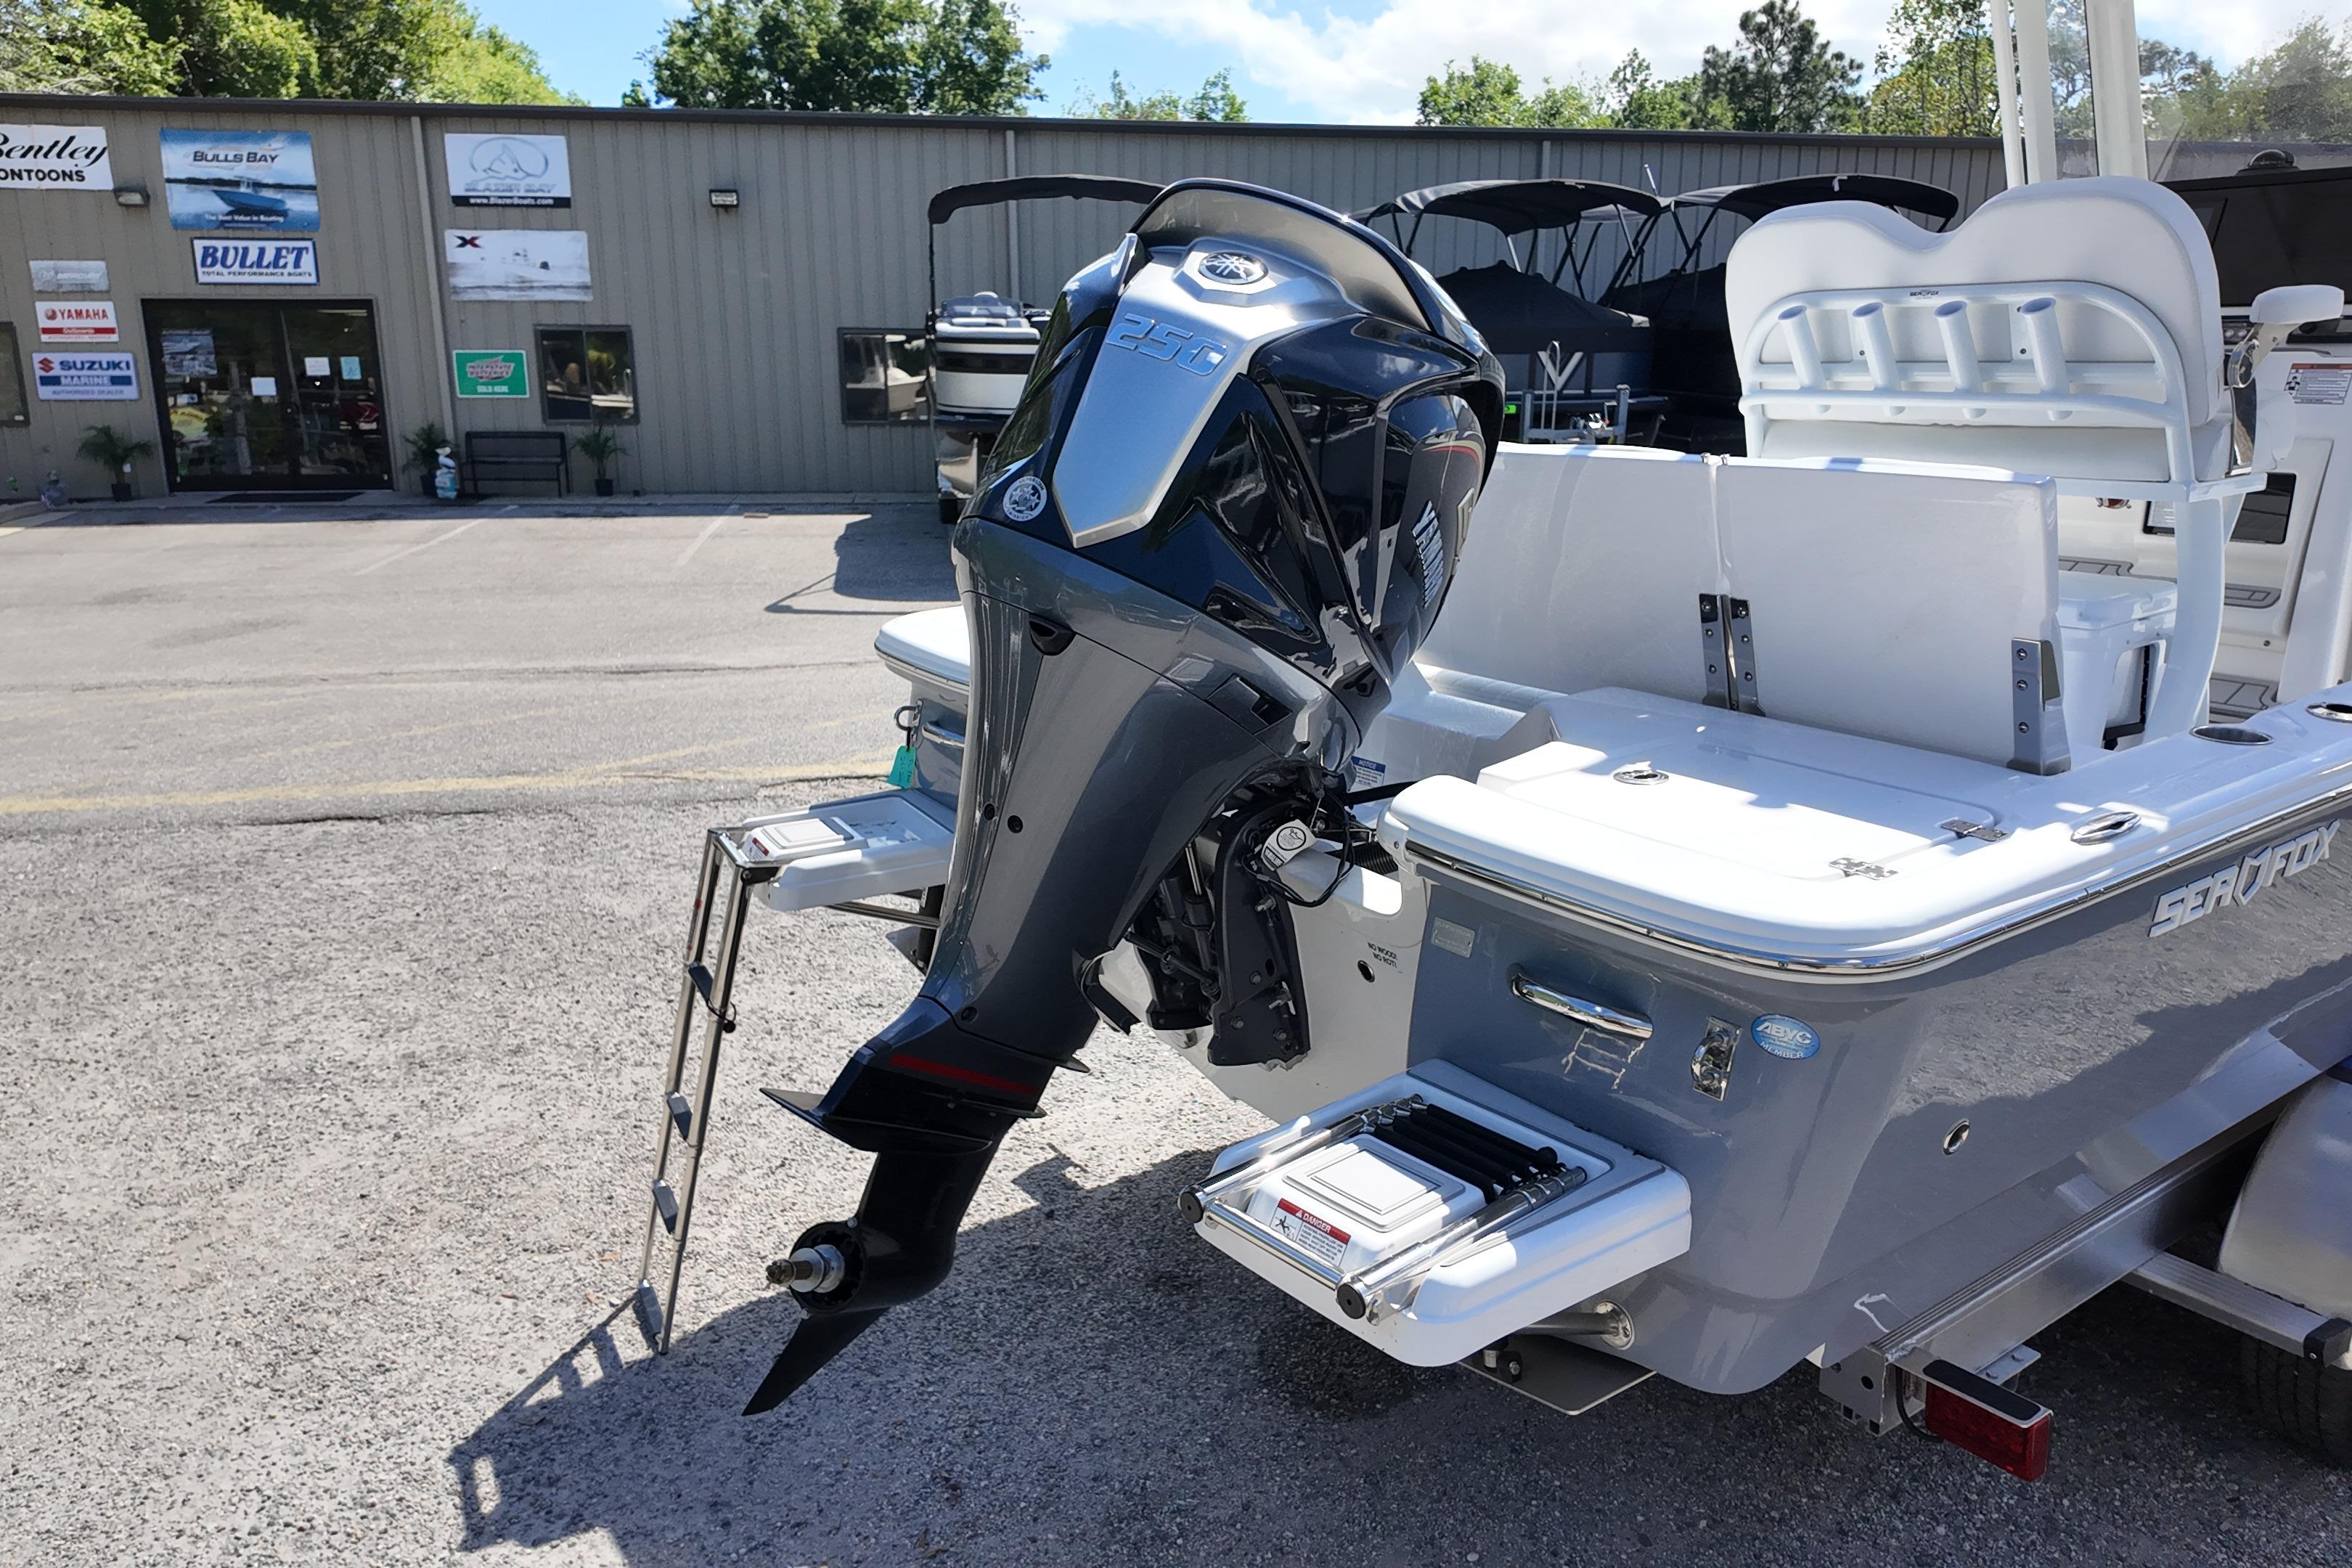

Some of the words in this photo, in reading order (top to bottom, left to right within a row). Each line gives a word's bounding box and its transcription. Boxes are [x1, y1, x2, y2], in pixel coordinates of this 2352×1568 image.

[193, 150, 244, 163] BULLS
[246, 151, 279, 163] BAY
[200, 245, 309, 269] BULLET
[59, 309, 109, 320] YAMAHA
[1106, 312, 1228, 376] 250
[60, 360, 131, 371] SUZUKI
[61, 375, 109, 385] MARINE
[1410, 499, 1445, 609] YAMAHA
[2147, 865, 2240, 938] SEA
[2263, 820, 2341, 887] FOX
[1756, 1021, 1812, 1044] ABYC
[1760, 1041, 1805, 1058] MEMBER
[1302, 1213, 1331, 1233] DANGER
